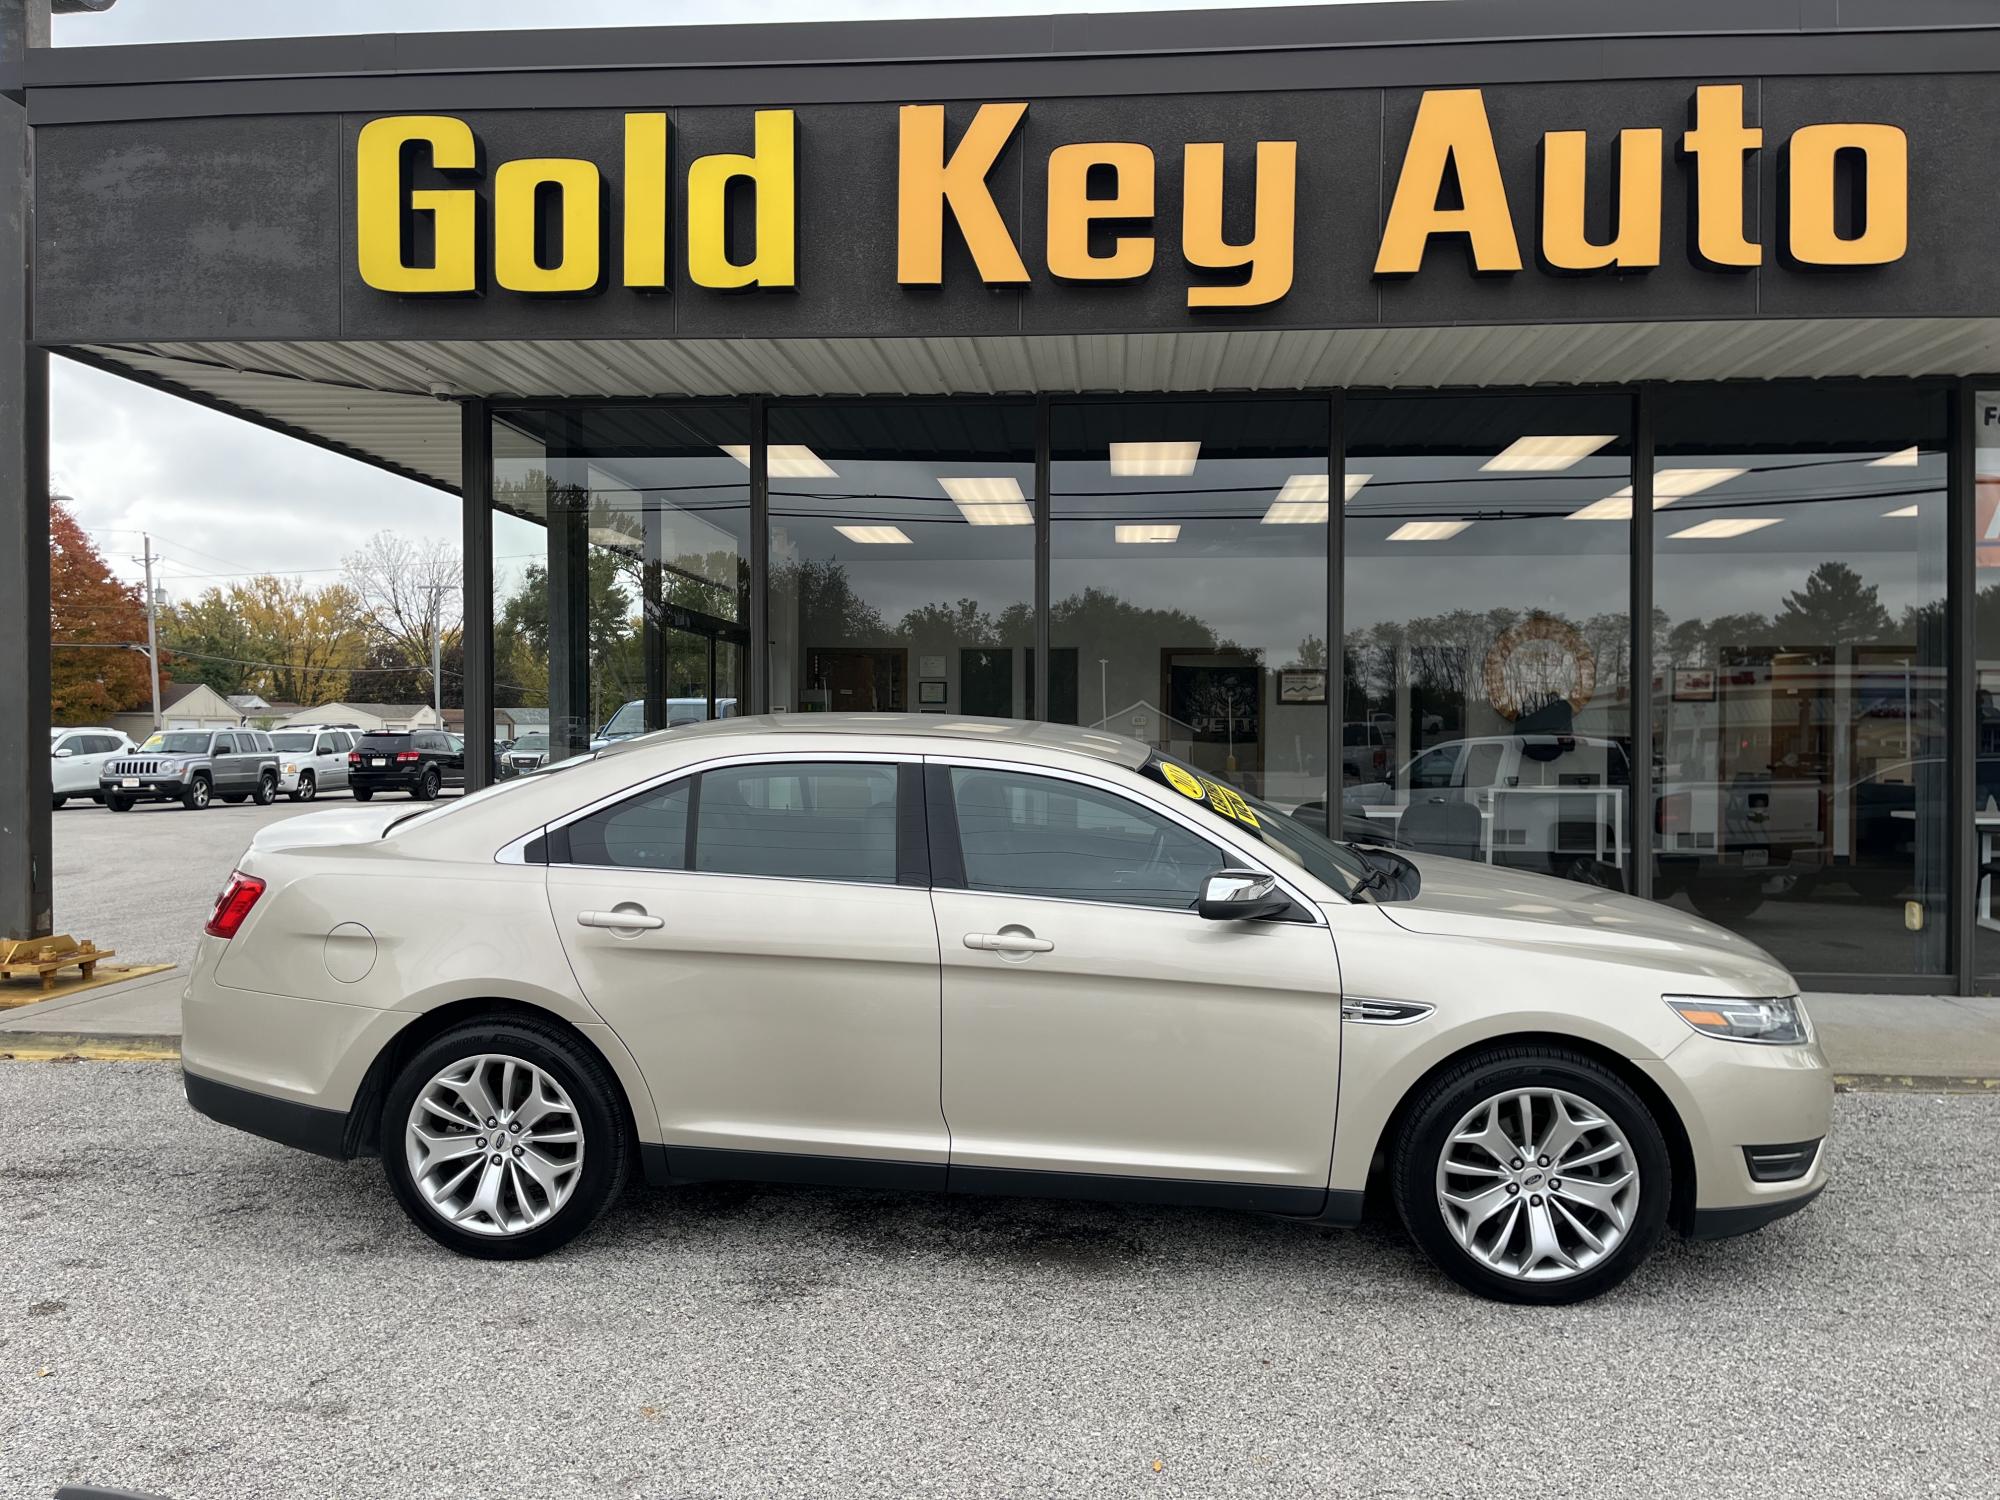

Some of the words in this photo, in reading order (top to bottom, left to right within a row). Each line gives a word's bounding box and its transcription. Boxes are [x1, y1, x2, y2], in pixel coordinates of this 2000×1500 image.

[357, 109, 796, 293] Gold
[897, 102, 1298, 307] Key
[1373, 84, 1908, 273] Auto
